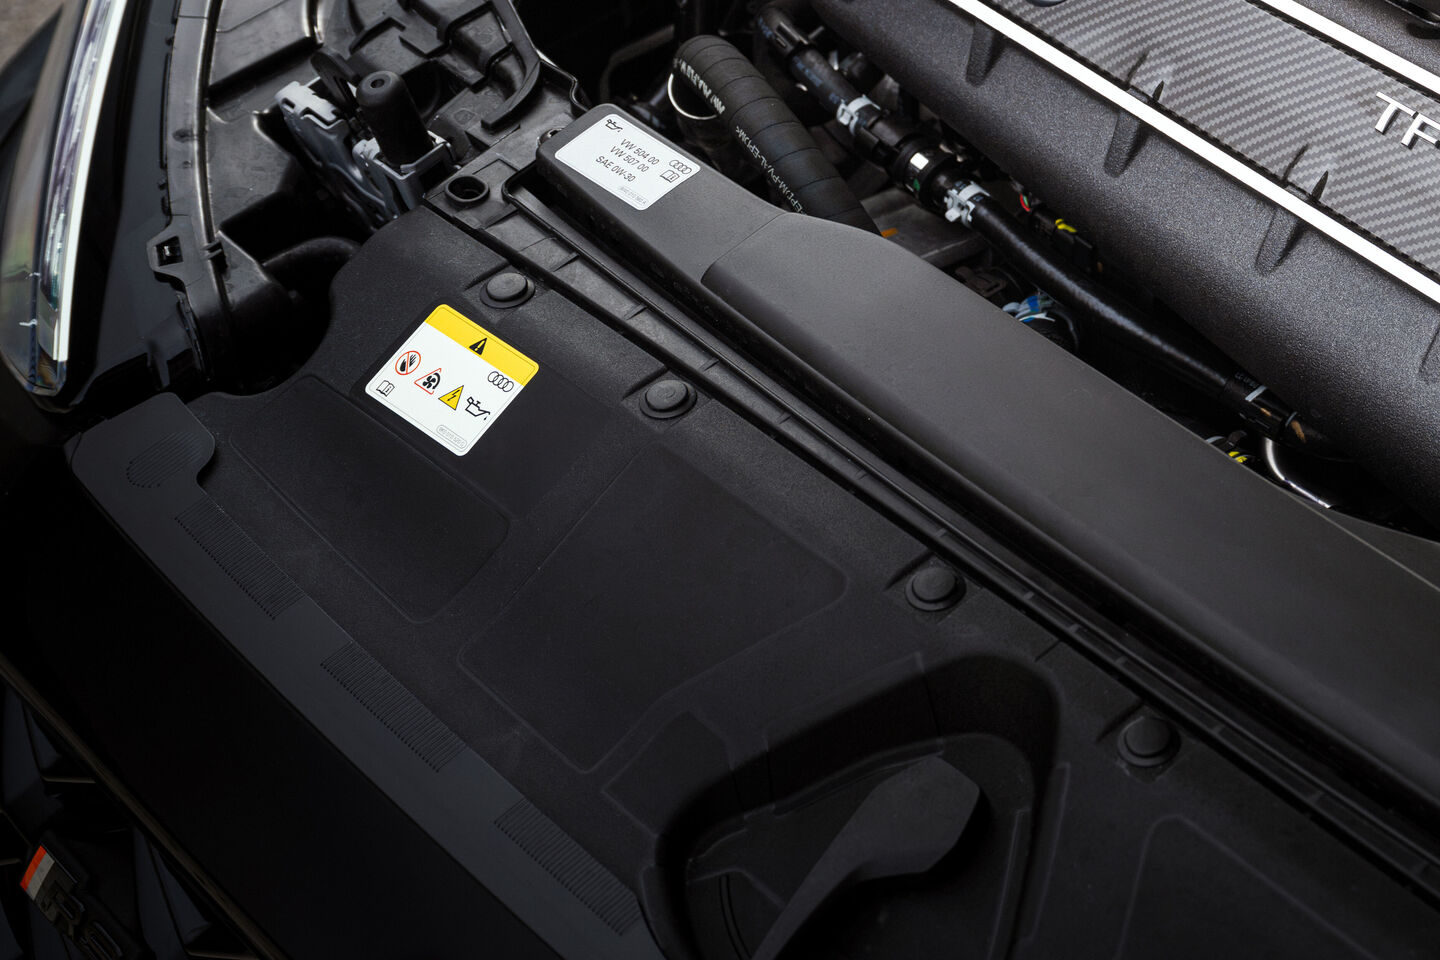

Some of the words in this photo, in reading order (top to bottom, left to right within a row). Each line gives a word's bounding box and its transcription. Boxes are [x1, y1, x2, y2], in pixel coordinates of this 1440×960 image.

[610, 145, 628, 158] VW
[622, 154, 641, 166] 507
[636, 163, 650, 173] 00
[620, 138, 638, 150] VW
[633, 147, 650, 159] 504
[647, 156, 660, 166] 00
[595, 155, 615, 169] SAE
[610, 165, 637, 182] 0W-30
